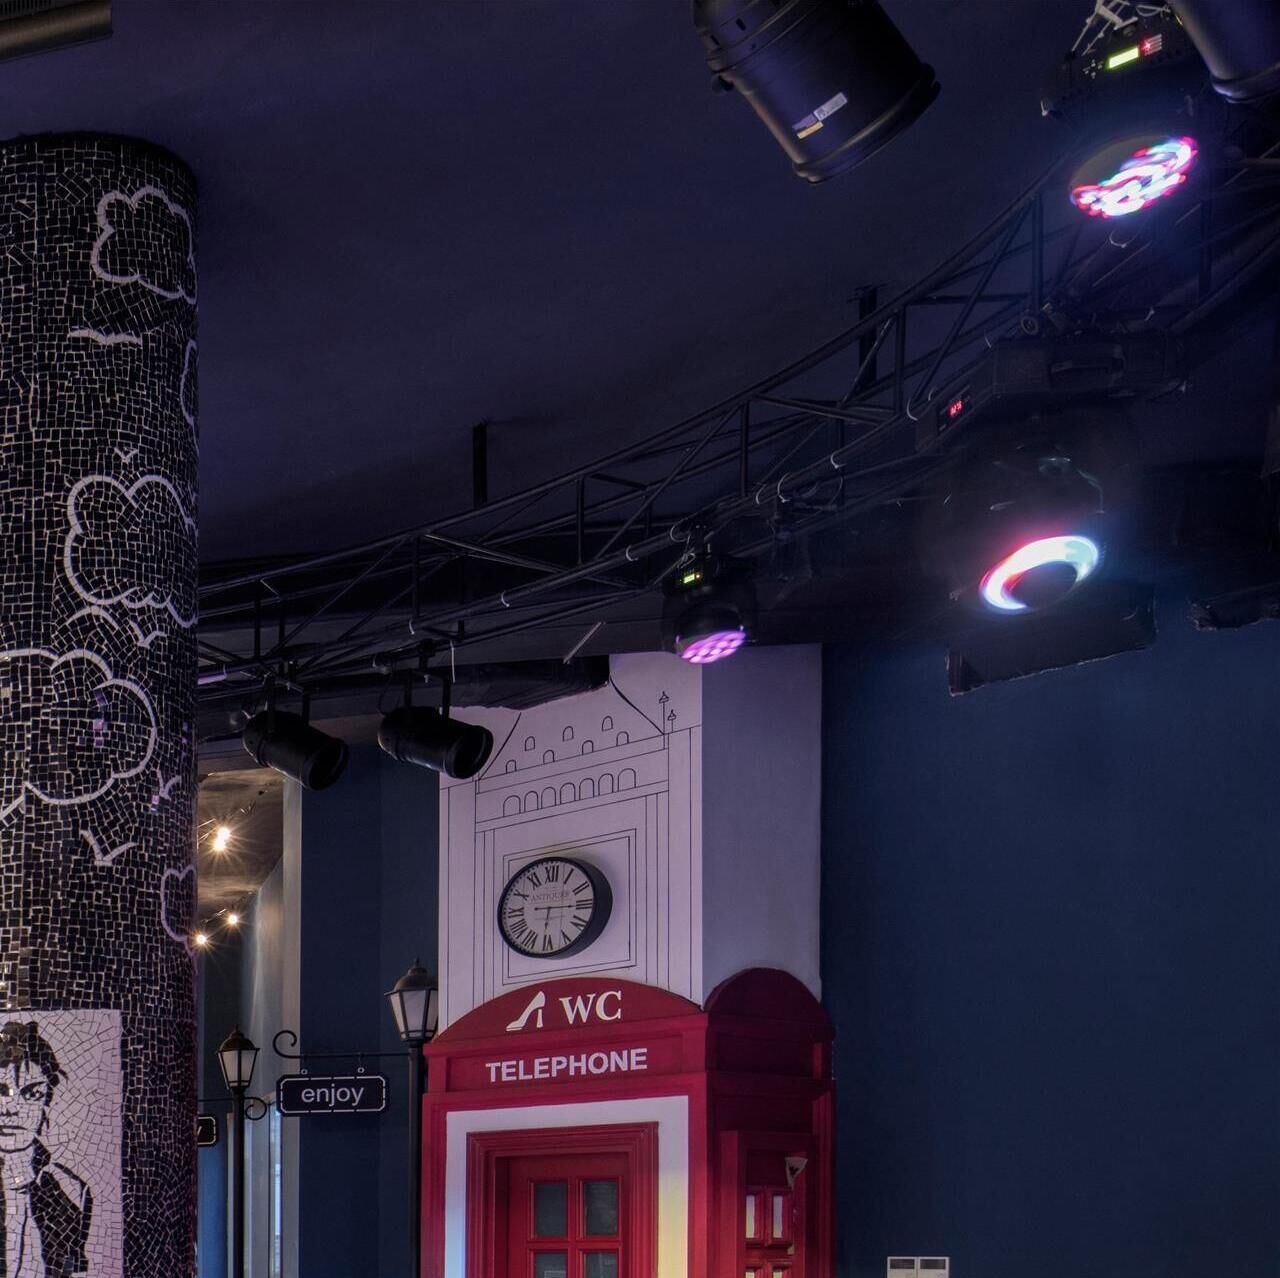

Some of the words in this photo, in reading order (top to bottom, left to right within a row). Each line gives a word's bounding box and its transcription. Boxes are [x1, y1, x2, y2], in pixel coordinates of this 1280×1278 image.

[558, 990, 622, 1025] WC
[485, 1048, 648, 1083] TELEPHONE
[301, 1084, 364, 1105] enjoy
